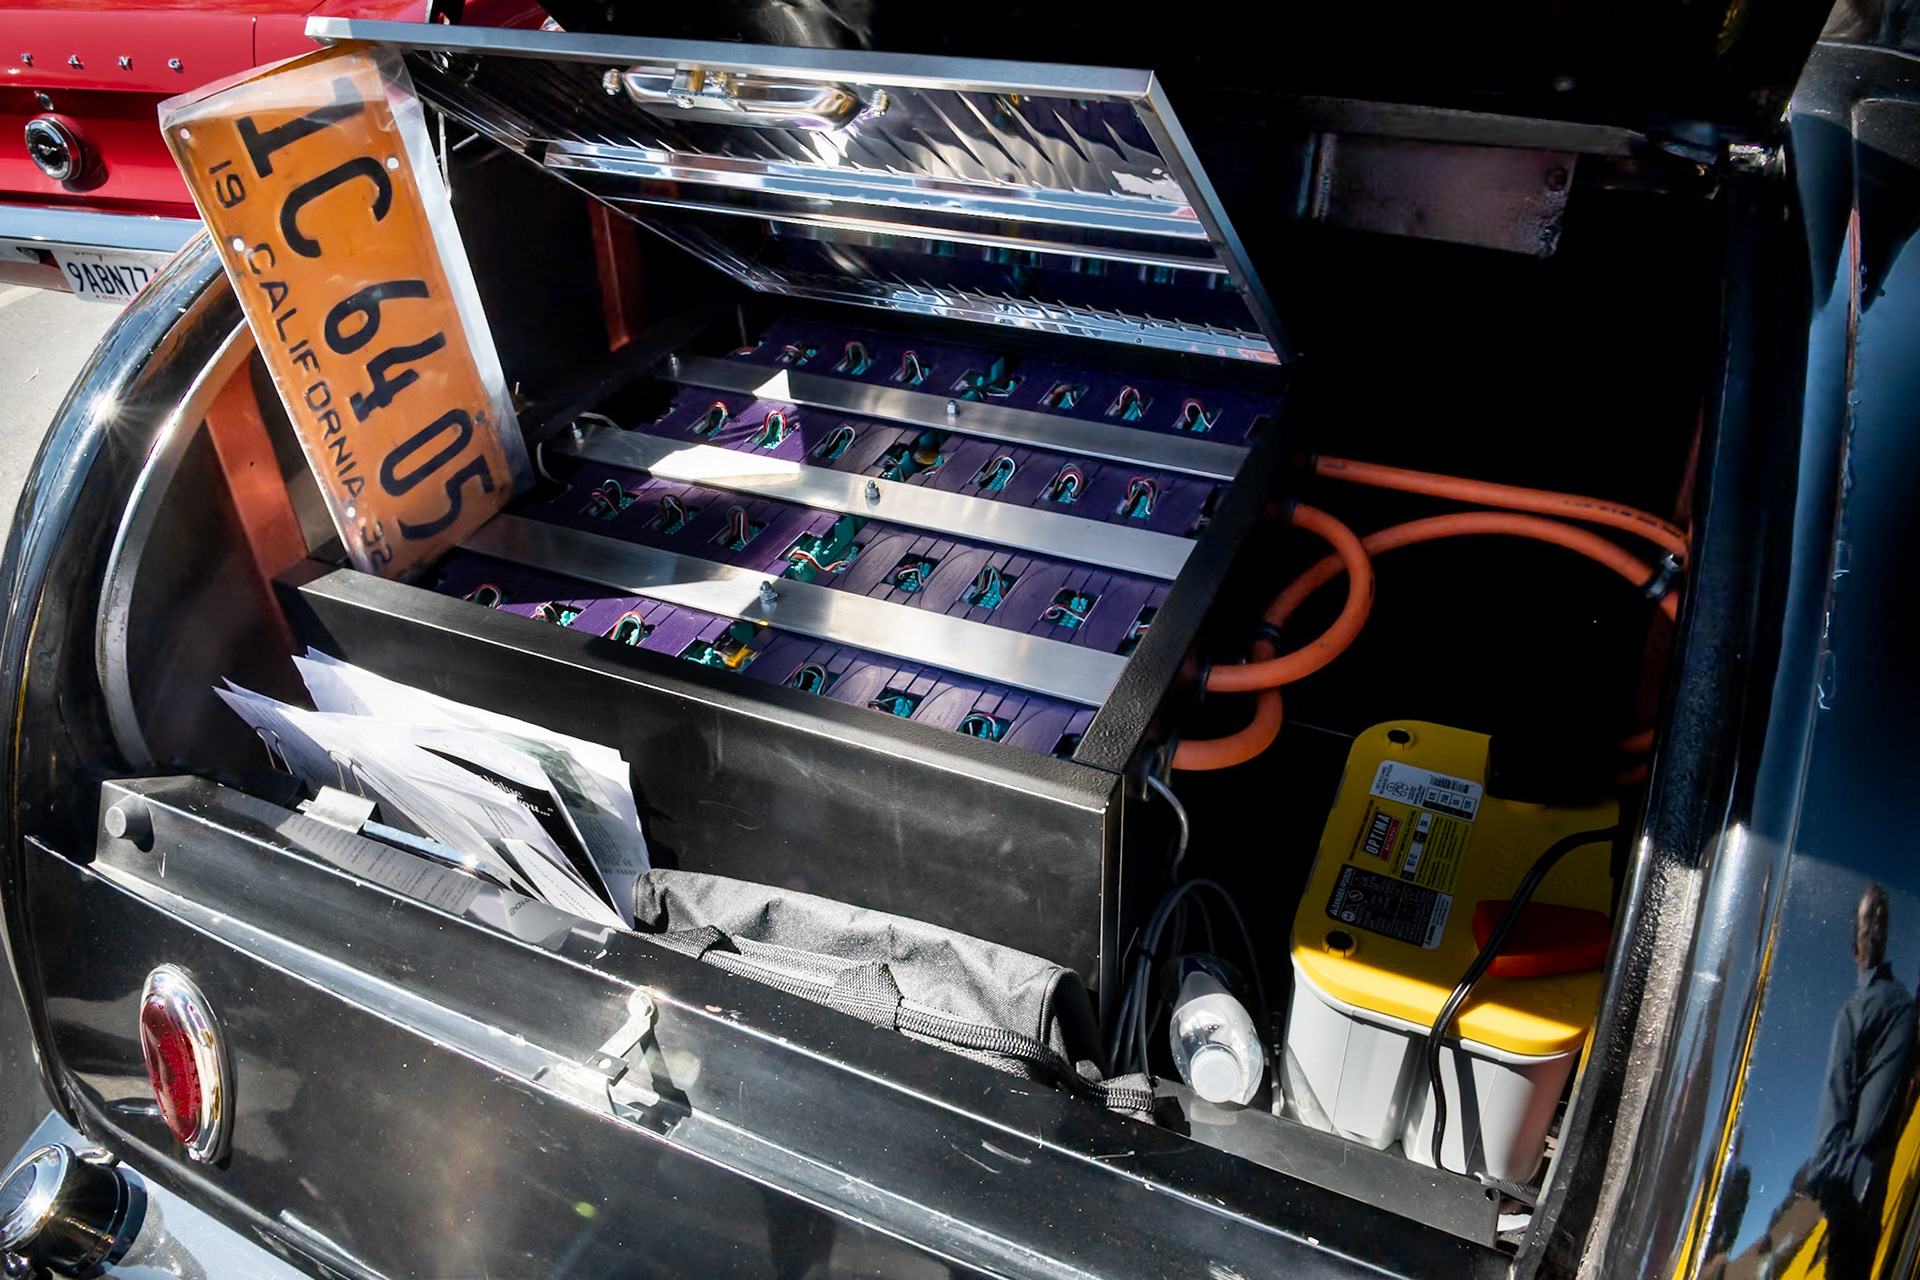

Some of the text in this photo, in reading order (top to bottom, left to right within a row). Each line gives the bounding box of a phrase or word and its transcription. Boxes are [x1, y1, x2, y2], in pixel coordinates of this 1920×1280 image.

[236, 78, 393, 259] 1C
[67, 262, 159, 296] 9ABN77
[207, 159, 247, 209] 19
[246, 243, 366, 500] CALIFORNIA
[1365, 813, 1391, 855] OPTIMA
